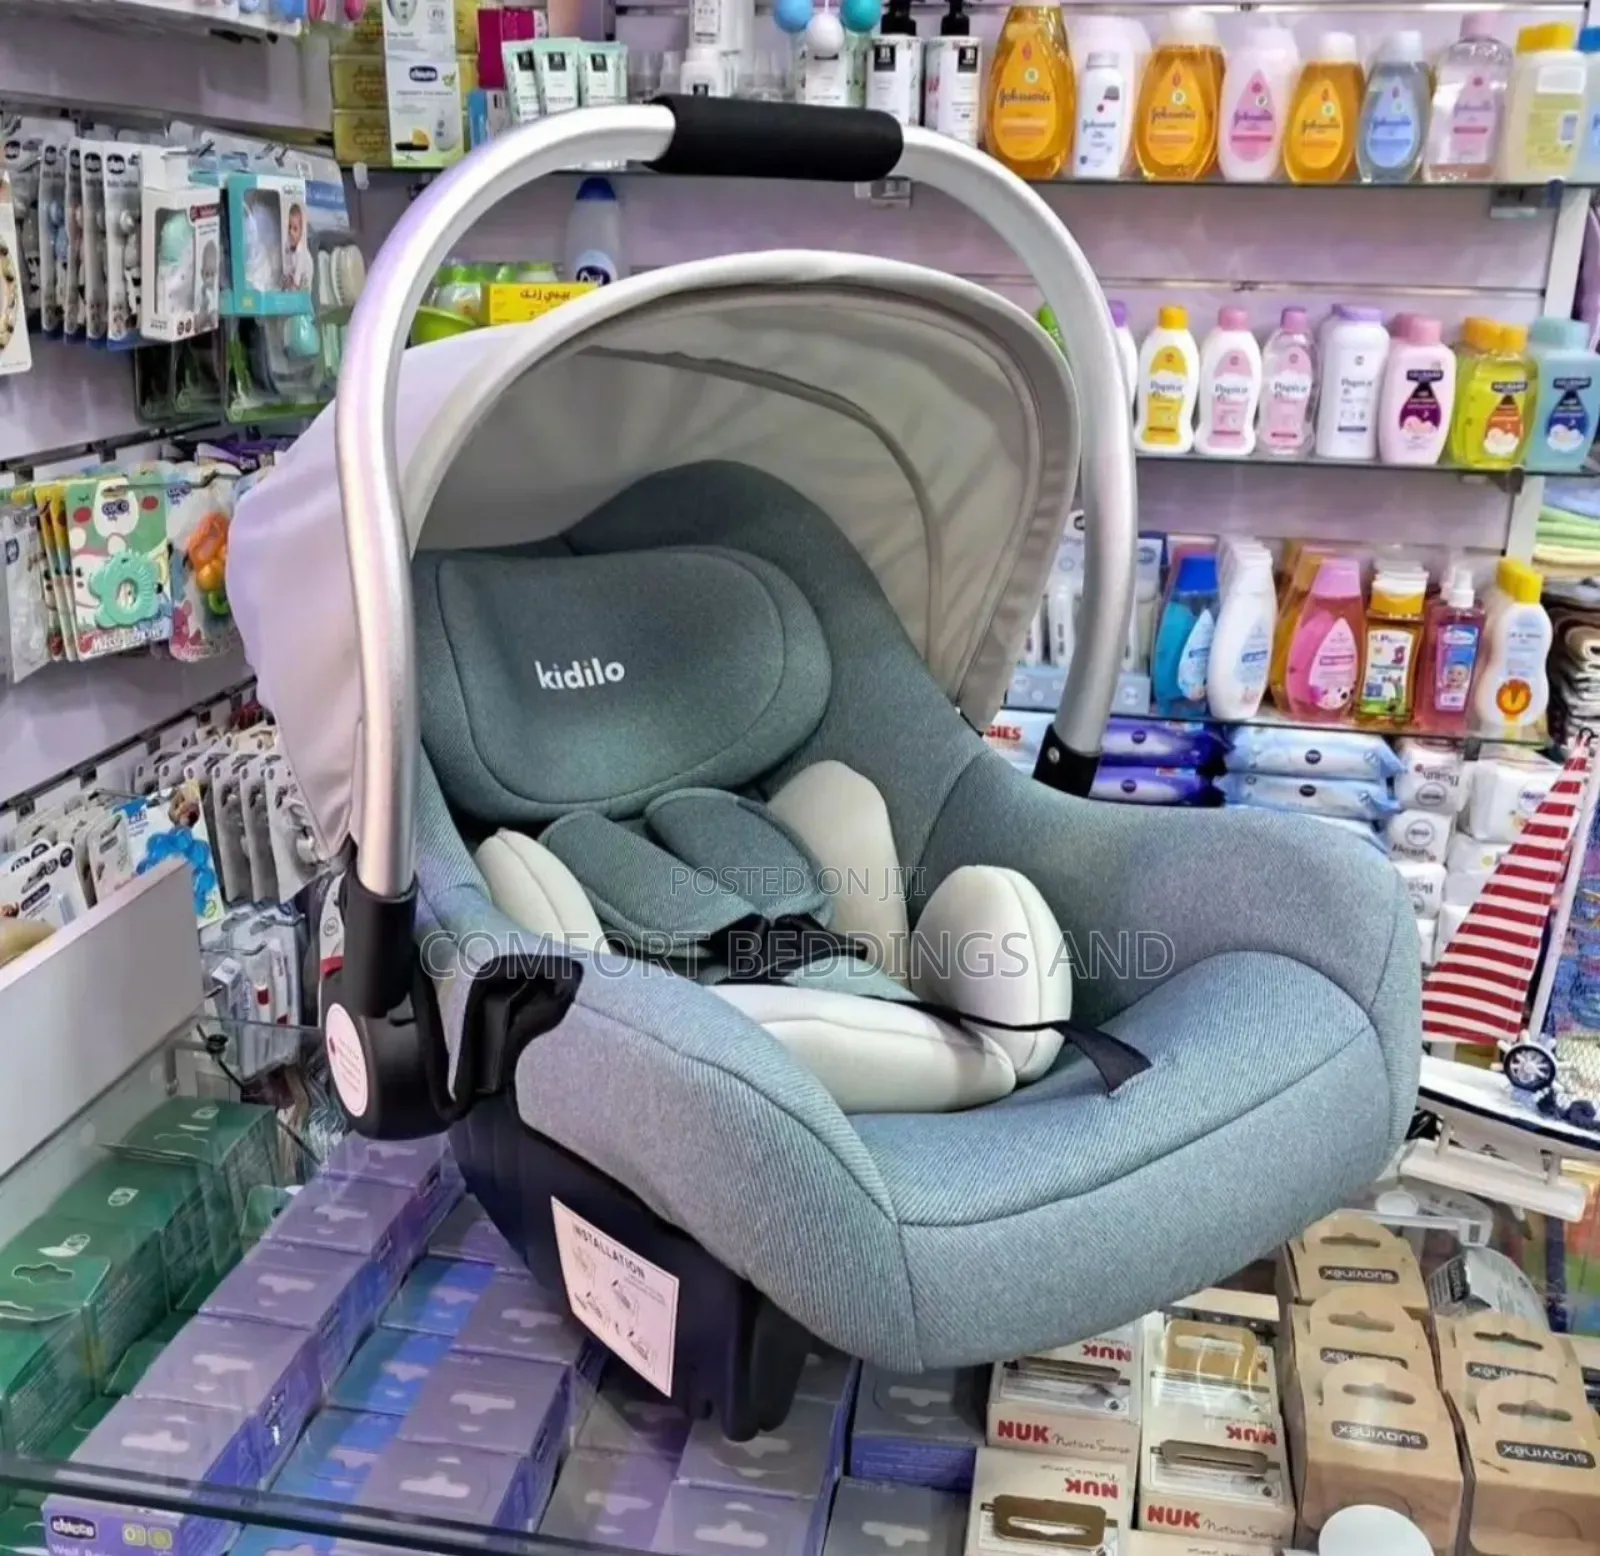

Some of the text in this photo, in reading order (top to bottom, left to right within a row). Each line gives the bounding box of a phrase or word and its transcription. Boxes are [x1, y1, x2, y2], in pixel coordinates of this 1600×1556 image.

[534, 657, 625, 690] kidilo
[986, 726, 1021, 742] GIES
[573, 1225, 646, 1280] INSTALLATION
[1082, 1344, 1132, 1363] NUK
[998, 1419, 1049, 1445] NUK
[1225, 1425, 1278, 1446] NUK
[1064, 1477, 1119, 1499] NUK
[1147, 1505, 1201, 1529] NUK
